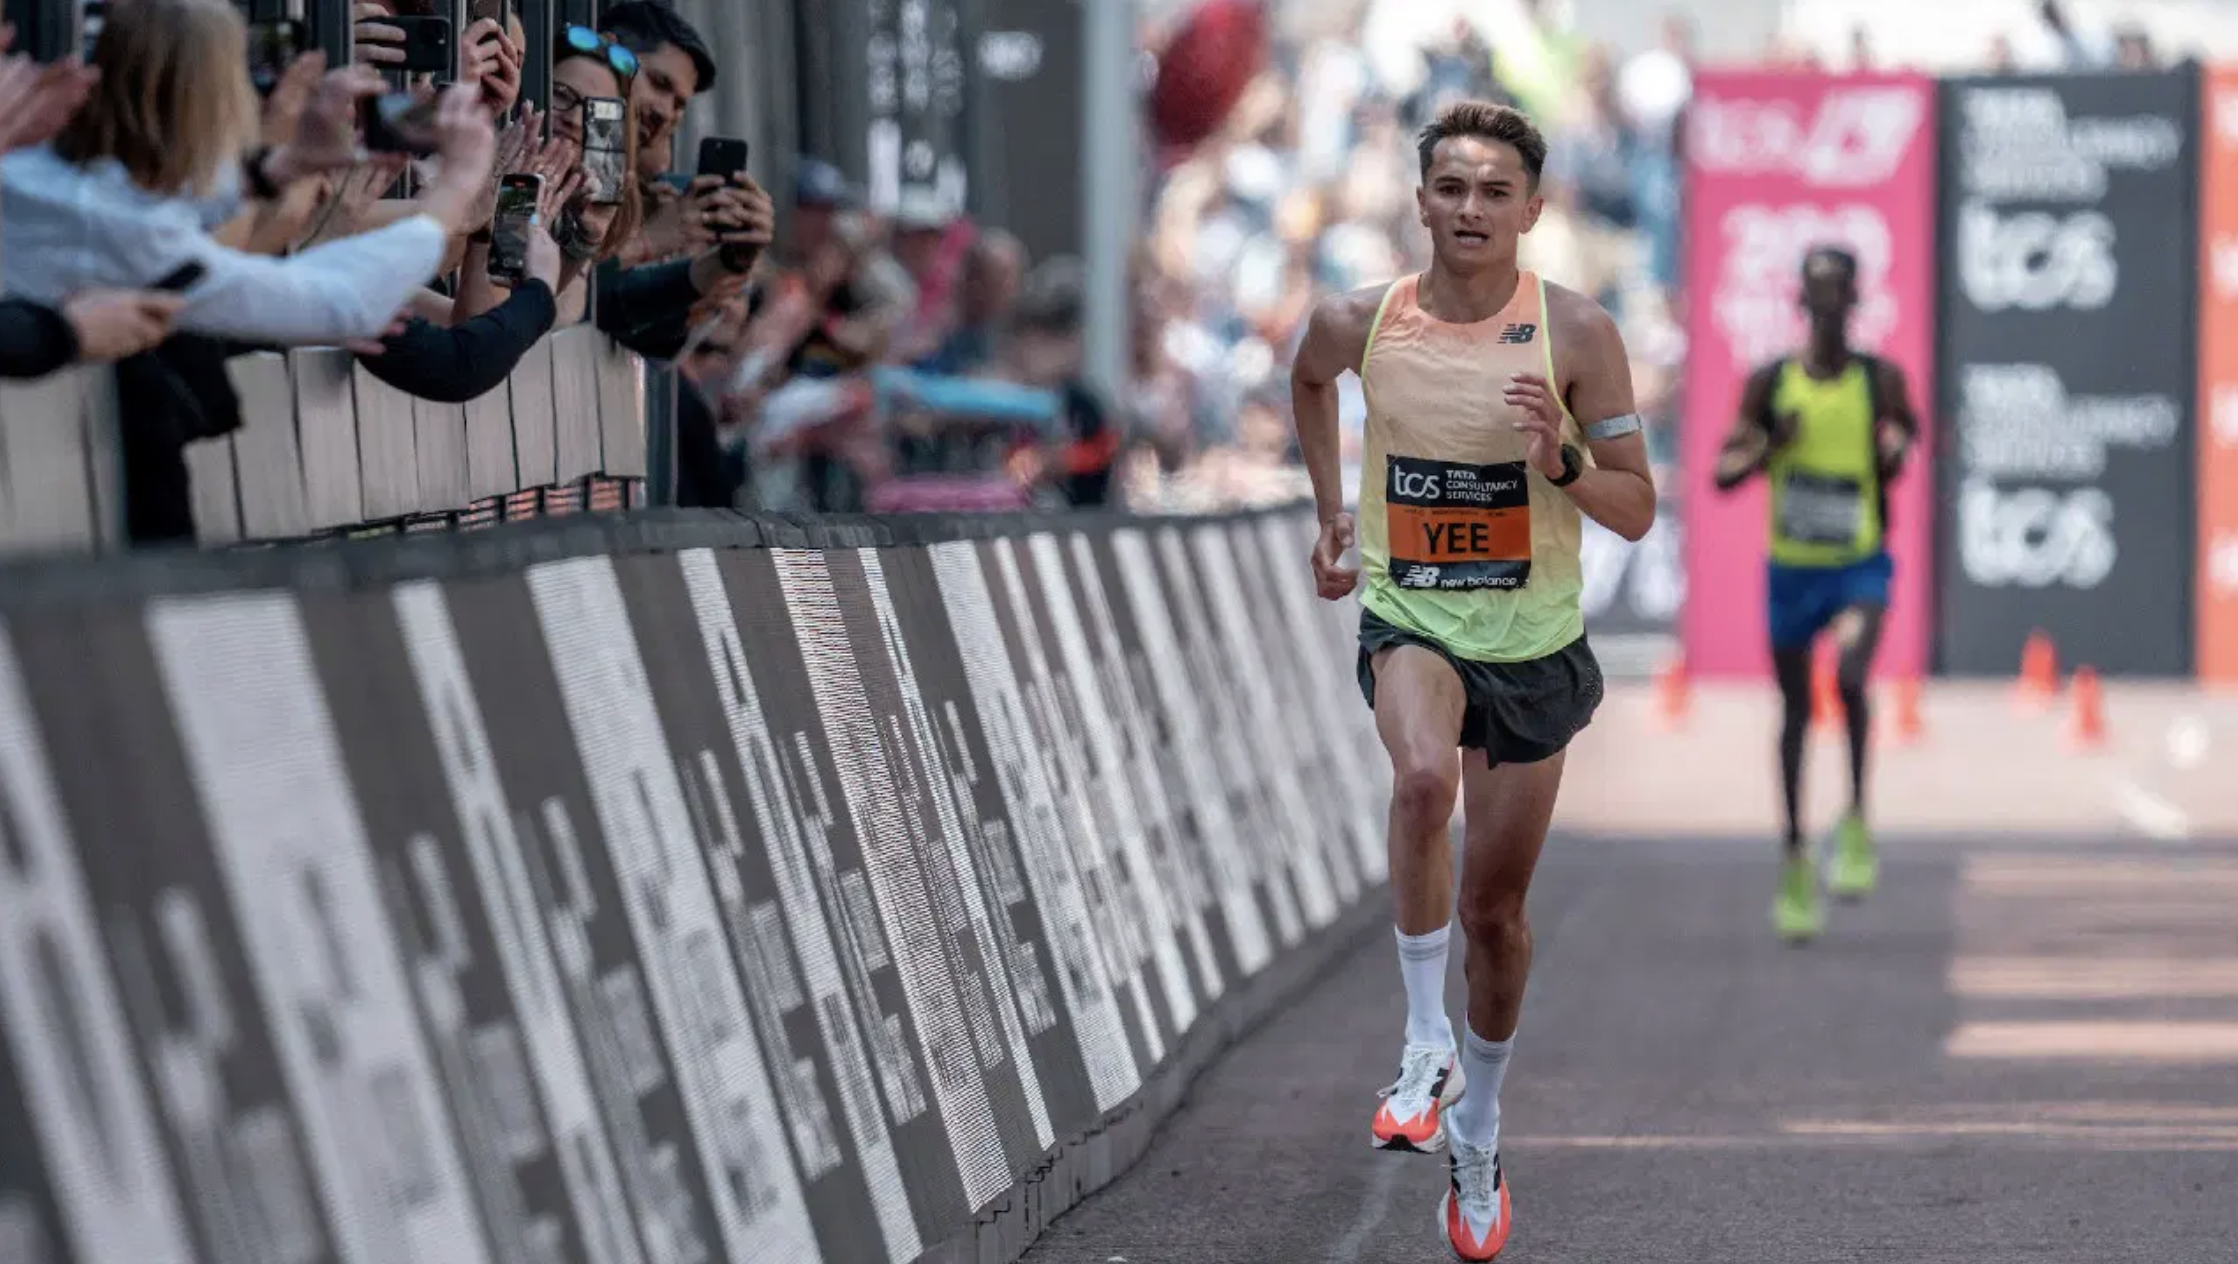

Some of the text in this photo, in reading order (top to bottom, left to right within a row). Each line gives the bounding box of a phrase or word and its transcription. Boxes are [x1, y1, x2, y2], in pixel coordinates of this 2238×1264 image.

[1446, 469, 1476, 480] TATA
[1394, 464, 1440, 499] tcs
[1446, 480, 1518, 493] CONSULTANCY
[1446, 490, 1493, 501] SERVICES
[1423, 522, 1489, 555] YEE
[1441, 578, 1466, 588] new
[1467, 576, 1518, 587] balance
